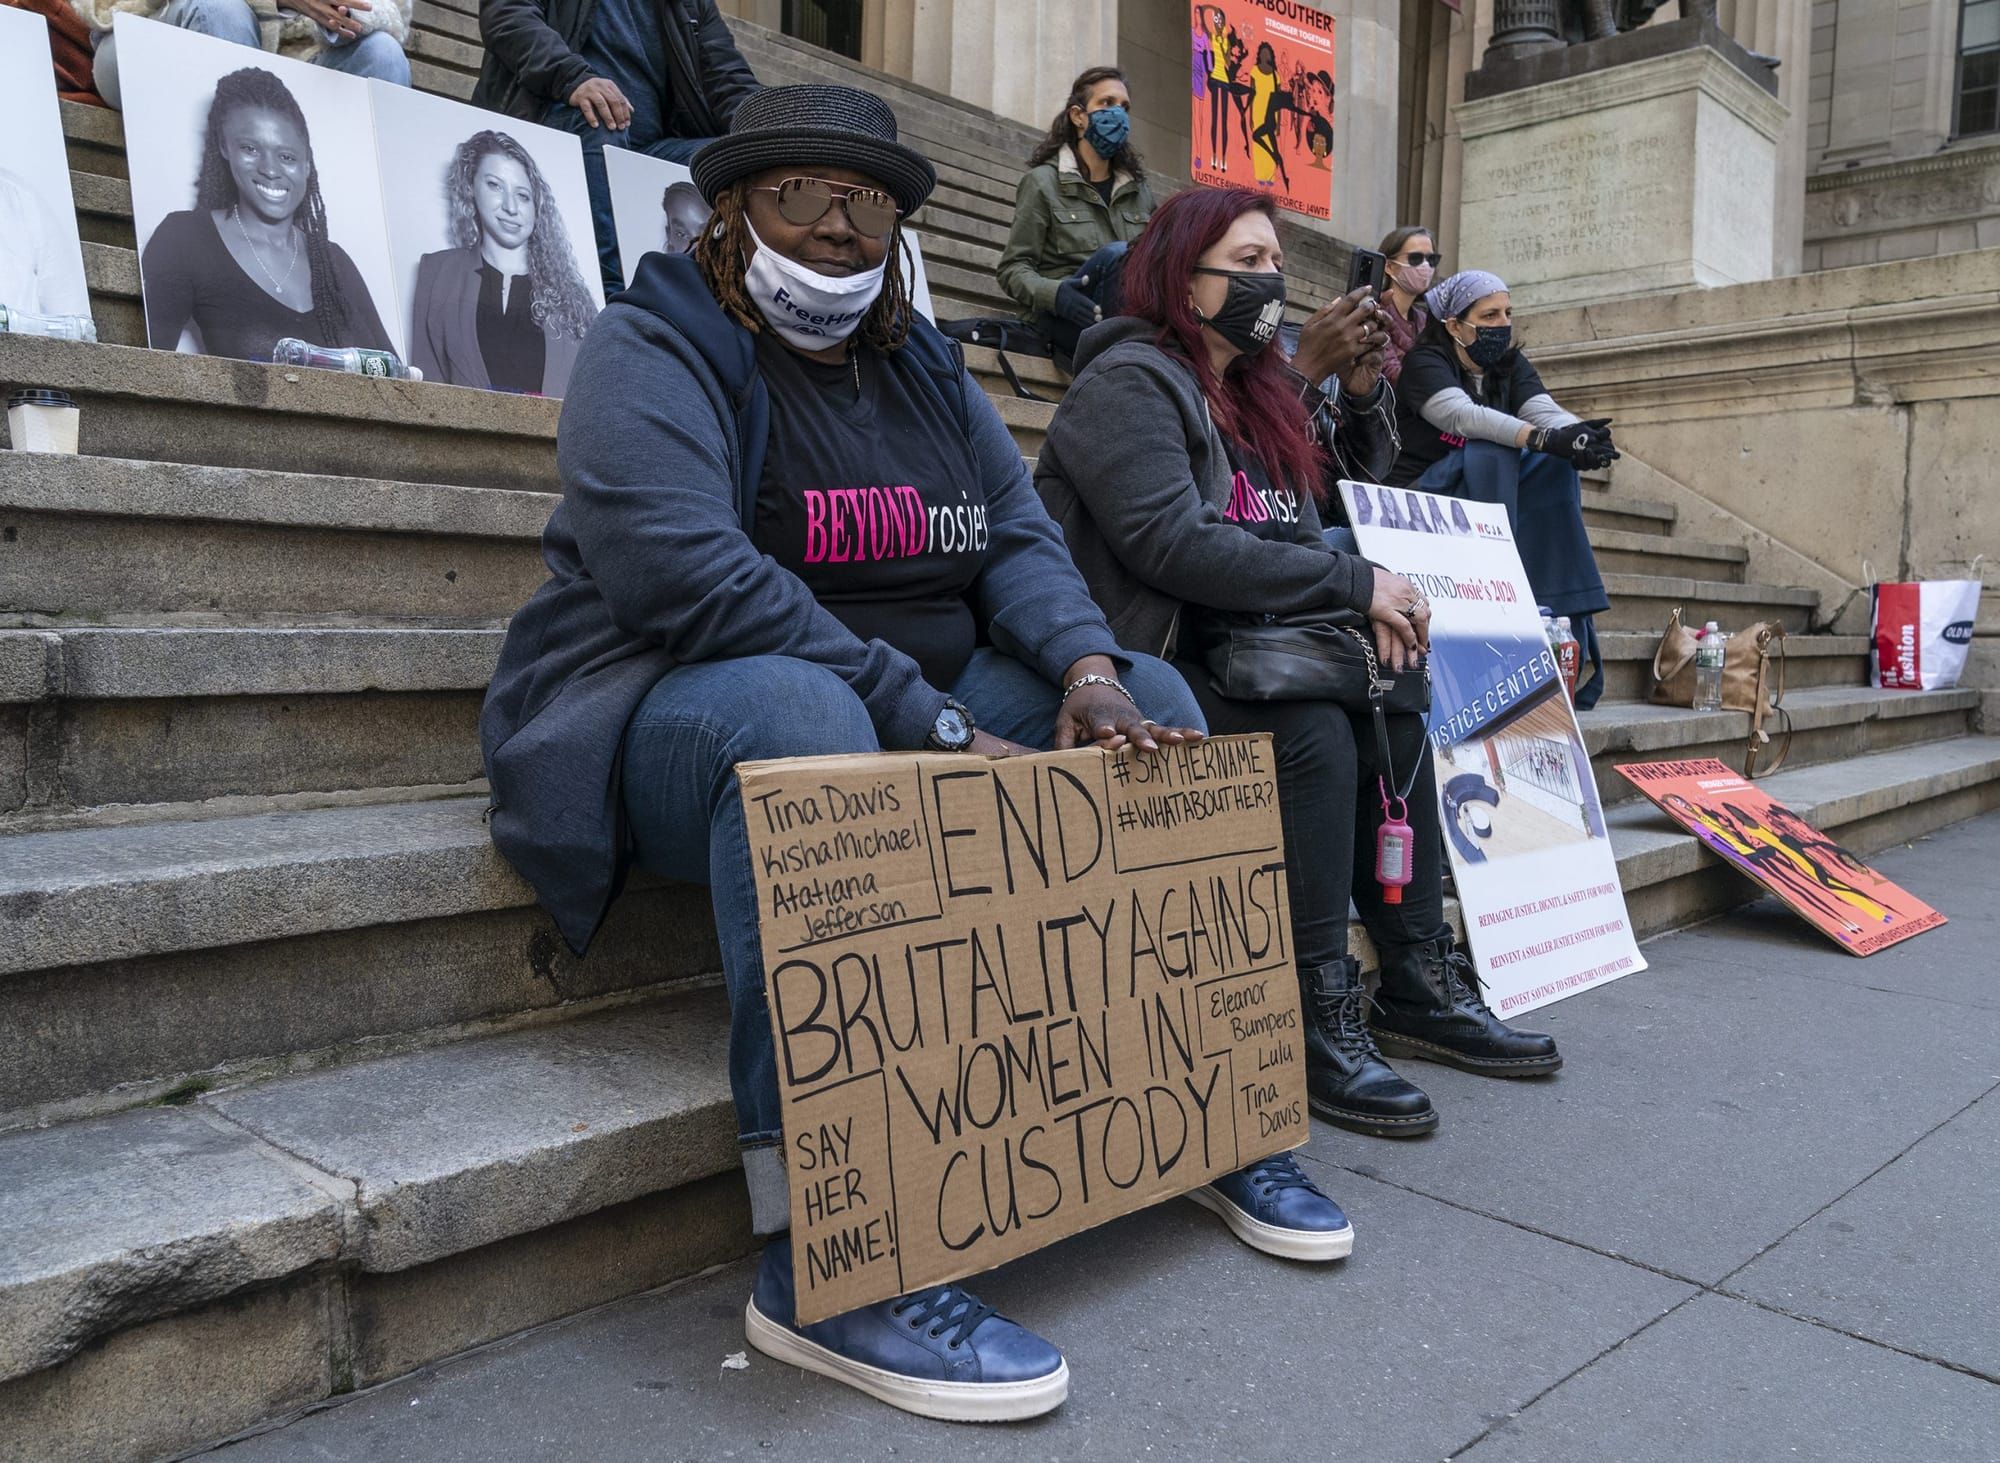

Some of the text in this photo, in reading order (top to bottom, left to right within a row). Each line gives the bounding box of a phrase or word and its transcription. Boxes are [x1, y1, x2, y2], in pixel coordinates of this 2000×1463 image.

[1299, 29, 1331, 48] TOGETHER
[773, 287, 866, 327] FreeHer
[1475, 521, 1503, 537] WCJA
[1490, 579, 1517, 602] 2020
[1430, 650, 1554, 751] USTICE CENTER
[751, 781, 900, 834] Tina Davis
[760, 819, 921, 878] Kisha Michael
[932, 765, 1103, 898] END
[773, 872, 879, 918] Atatiana
[1478, 908, 1514, 928] REIMAGINE
[1586, 885, 1598, 899] FOR
[1597, 882, 1616, 896] WOMEN
[800, 900, 907, 942] Jefferson
[1490, 949, 1520, 970] REINVENT
[1526, 940, 1553, 958] SMALLER
[1553, 933, 1574, 950] JUSTICE
[1574, 927, 1595, 943] SYSTEM
[1594, 924, 1606, 937] FOR
[1605, 919, 1624, 934] WOMEN
[772, 862, 1287, 1087] BRUTALITY AGAINST
[1500, 991, 1530, 1011] REINVEST
[1530, 983, 1556, 1000] SAVINGS
[1556, 980, 1565, 992] TO
[1564, 968, 1598, 988] STRENGTHEN
[1211, 980, 1268, 1018] Eleanor
[1231, 1008, 1296, 1042] Bumpers
[896, 987, 1194, 1145] WOMEN IN
[1259, 1040, 1293, 1071] Lulu
[1240, 1083, 1279, 1115] Tina
[1259, 1101, 1301, 1138] Davis
[796, 1116, 855, 1171] SAY
[938, 1063, 1219, 1251] CUSTODY
[804, 1168, 867, 1226] HER
[807, 1210, 897, 1290] NAME!
